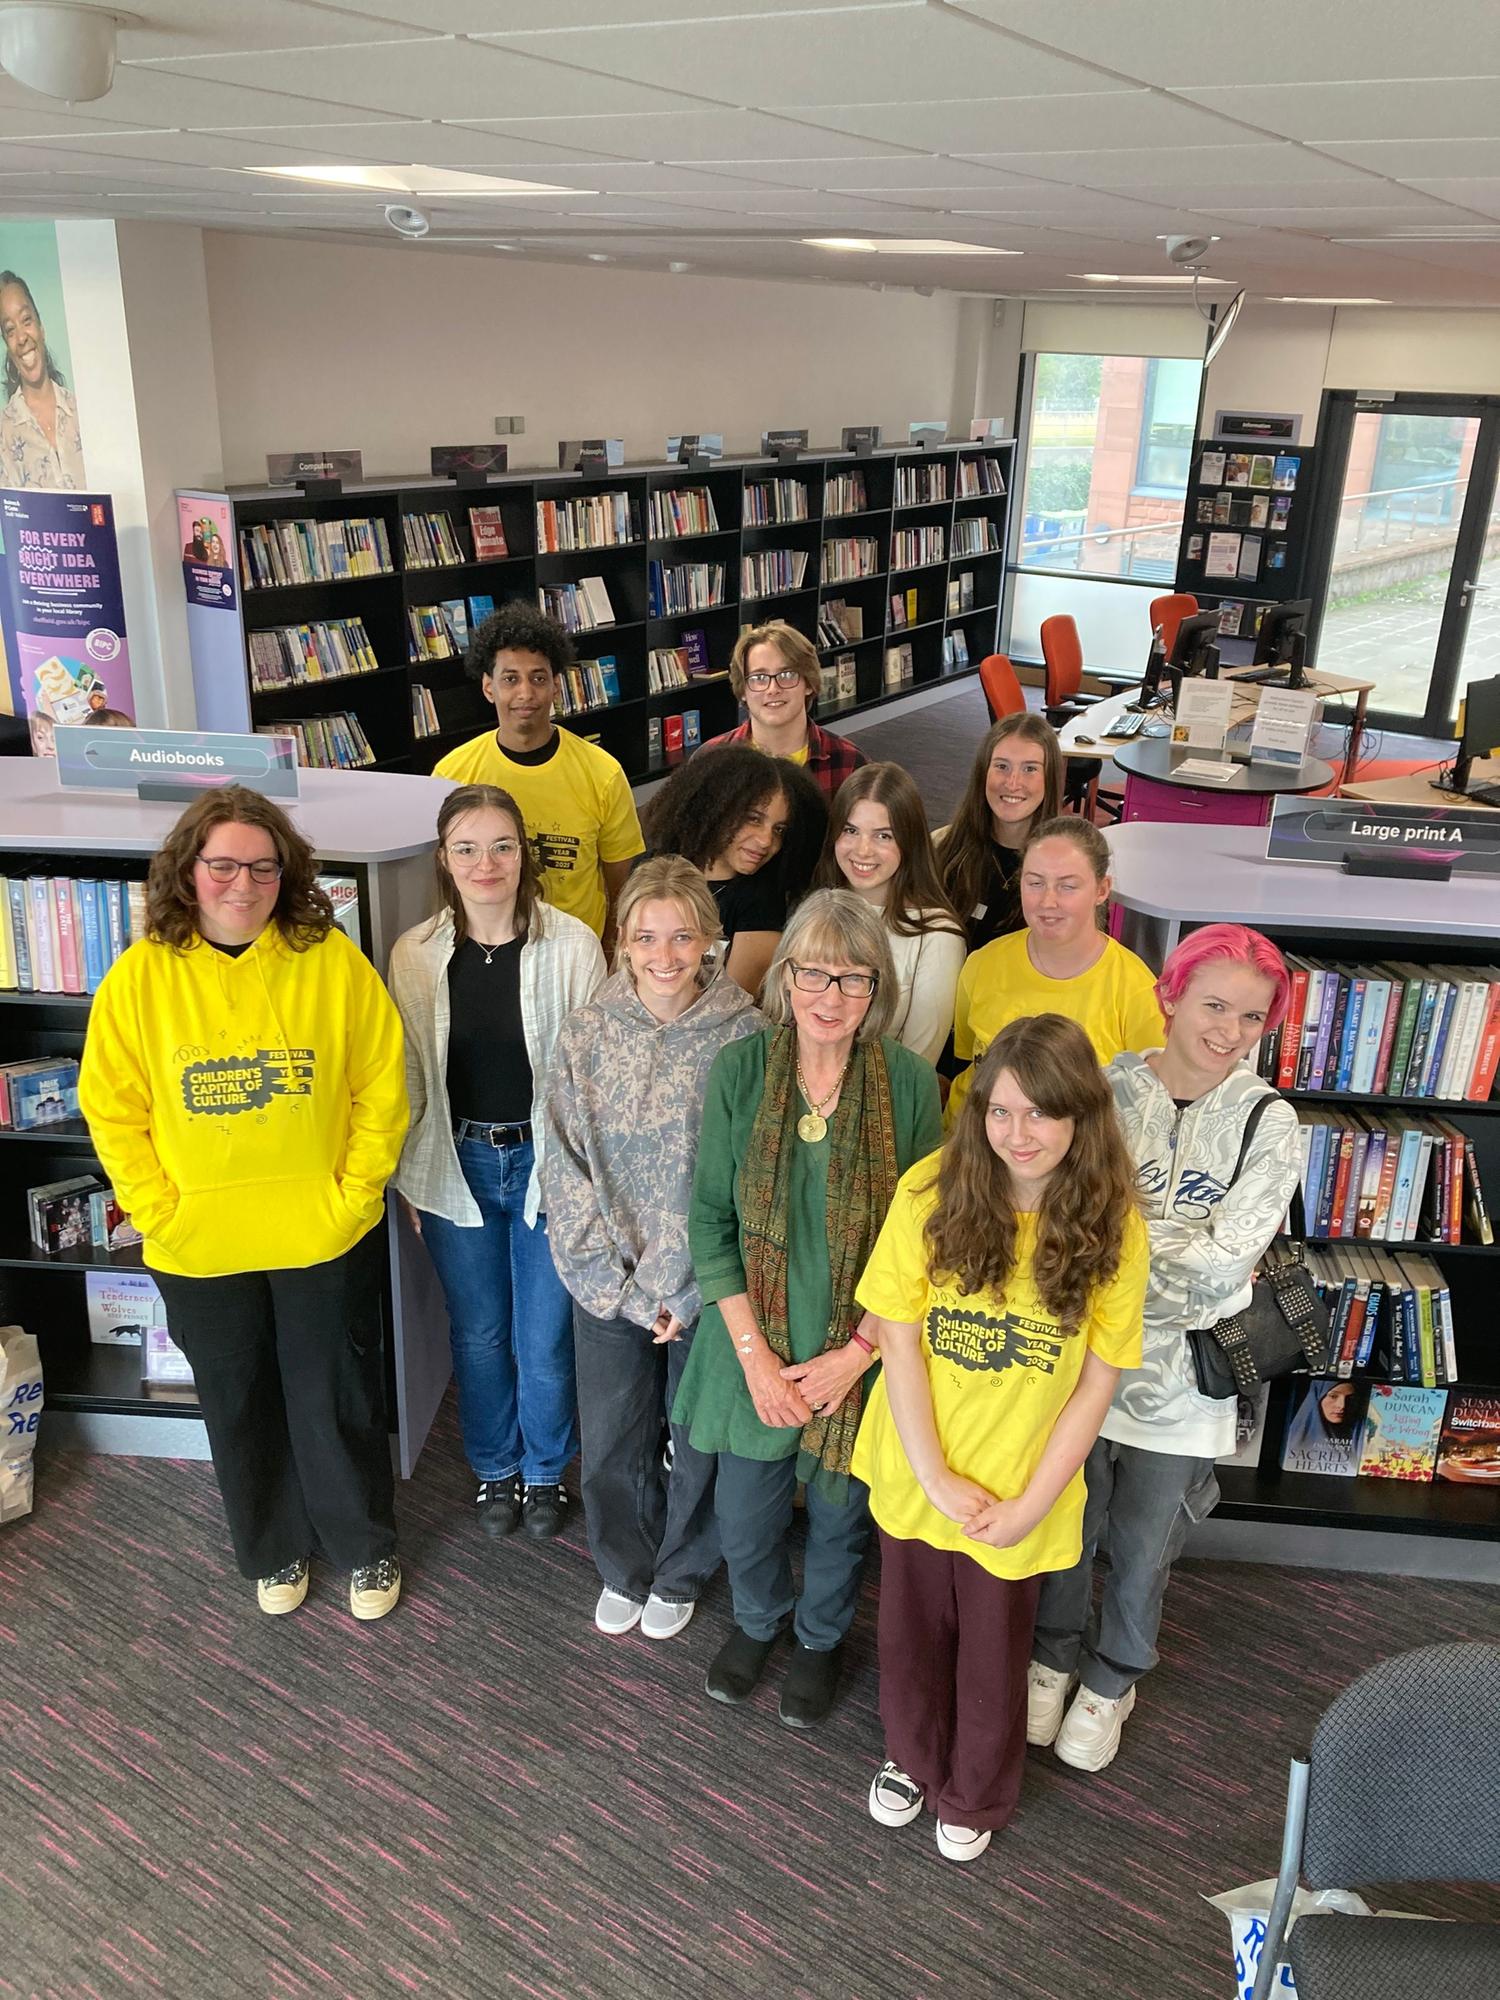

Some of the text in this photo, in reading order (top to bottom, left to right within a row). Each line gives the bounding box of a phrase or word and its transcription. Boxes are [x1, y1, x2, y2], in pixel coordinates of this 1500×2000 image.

[299, 461, 334, 472] Computers
[19, 530, 86, 547] FOR EVERY
[19, 550, 96, 568] BRIGHT IDEA
[19, 570, 101, 588] EVERYWHERE
[130, 748, 224, 767] Audiobooks
[546, 835, 576, 844] FESTIVAL
[1350, 821, 1463, 843] Large print A
[1346, 993, 1362, 1052] MARGARET BACON
[1282, 1022, 1294, 1056] HEARTS
[1290, 1023, 1301, 1056] FALLEN
[189, 1067, 262, 1084] CHILDREN'S
[280, 1068, 304, 1076] YR
[191, 1079, 263, 1096] CAPITAL OF
[98, 1290, 154, 1303] Tenderness
[1365, 1291, 1381, 1316] CHAOS
[101, 1303, 137, 1315] Wolves
[937, 1314, 1007, 1341] CHILDREN'S
[1018, 1319, 1062, 1337] FESTIVAL
[937, 1326, 1006, 1352] CAPITAL OF
[1026, 1339, 1051, 1353] YEAR
[1026, 1357, 1048, 1370] 2025
[1393, 1391, 1430, 1404] Sarah
[1384, 1402, 1437, 1415] DUNCAN
[1452, 1407, 1500, 1419] DUNLA
[1450, 1416, 1500, 1429] Switchbac
[1288, 1449, 1350, 1463] SACRED
[1295, 1459, 1348, 1473] HEARTS
